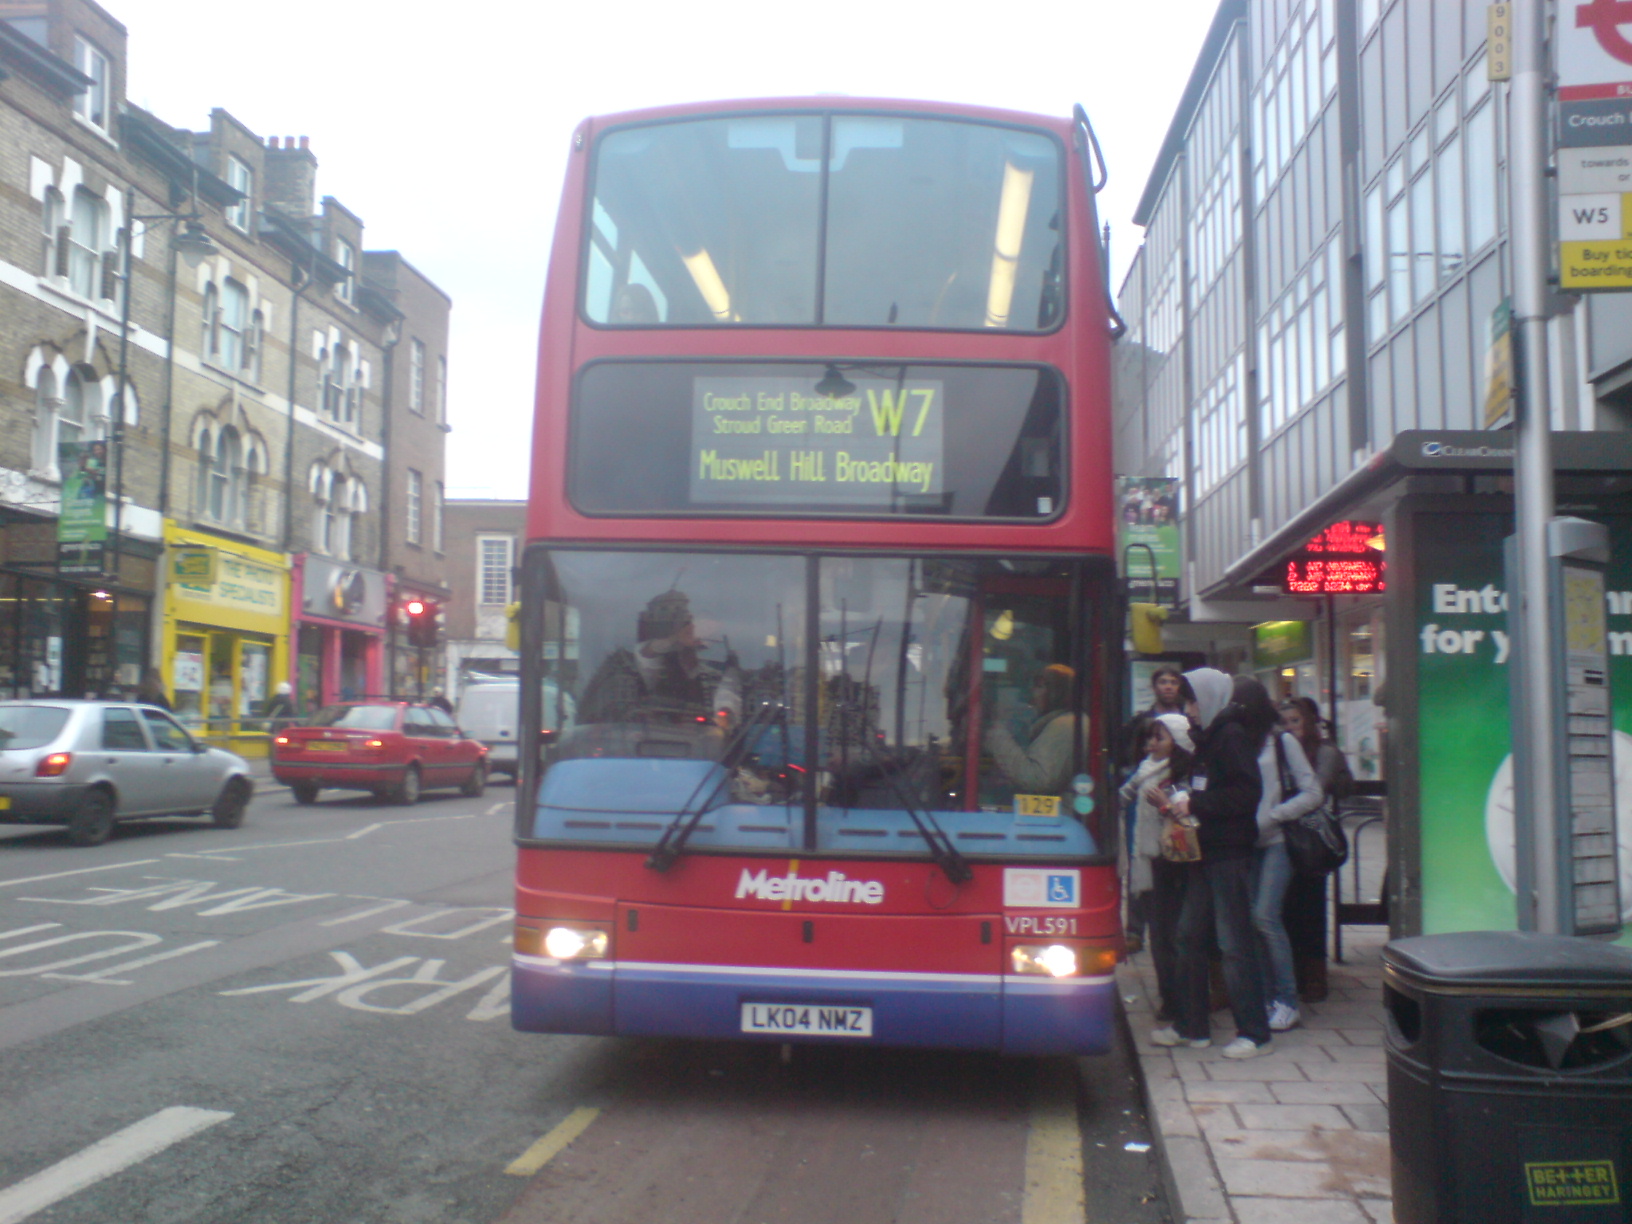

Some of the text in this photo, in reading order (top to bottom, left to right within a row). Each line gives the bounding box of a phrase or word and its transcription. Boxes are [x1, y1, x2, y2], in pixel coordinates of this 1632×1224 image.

[1568, 112, 1625, 127] Crouch
[1581, 159, 1629, 168] towards
[1573, 207, 1609, 224] W5
[1583, 249, 1610, 262] Buy
[703, 388, 936, 437] Crouch End Broadway W7
[713, 415, 854, 434] Stroud Green Road
[699, 450, 934, 493] Muswell Hill Broadway
[1420, 623, 1484, 654] for
[735, 867, 884, 905] Metroline
[1004, 916, 1078, 935] VPL591
[752, 1007, 864, 1032] LK04 NMZ
